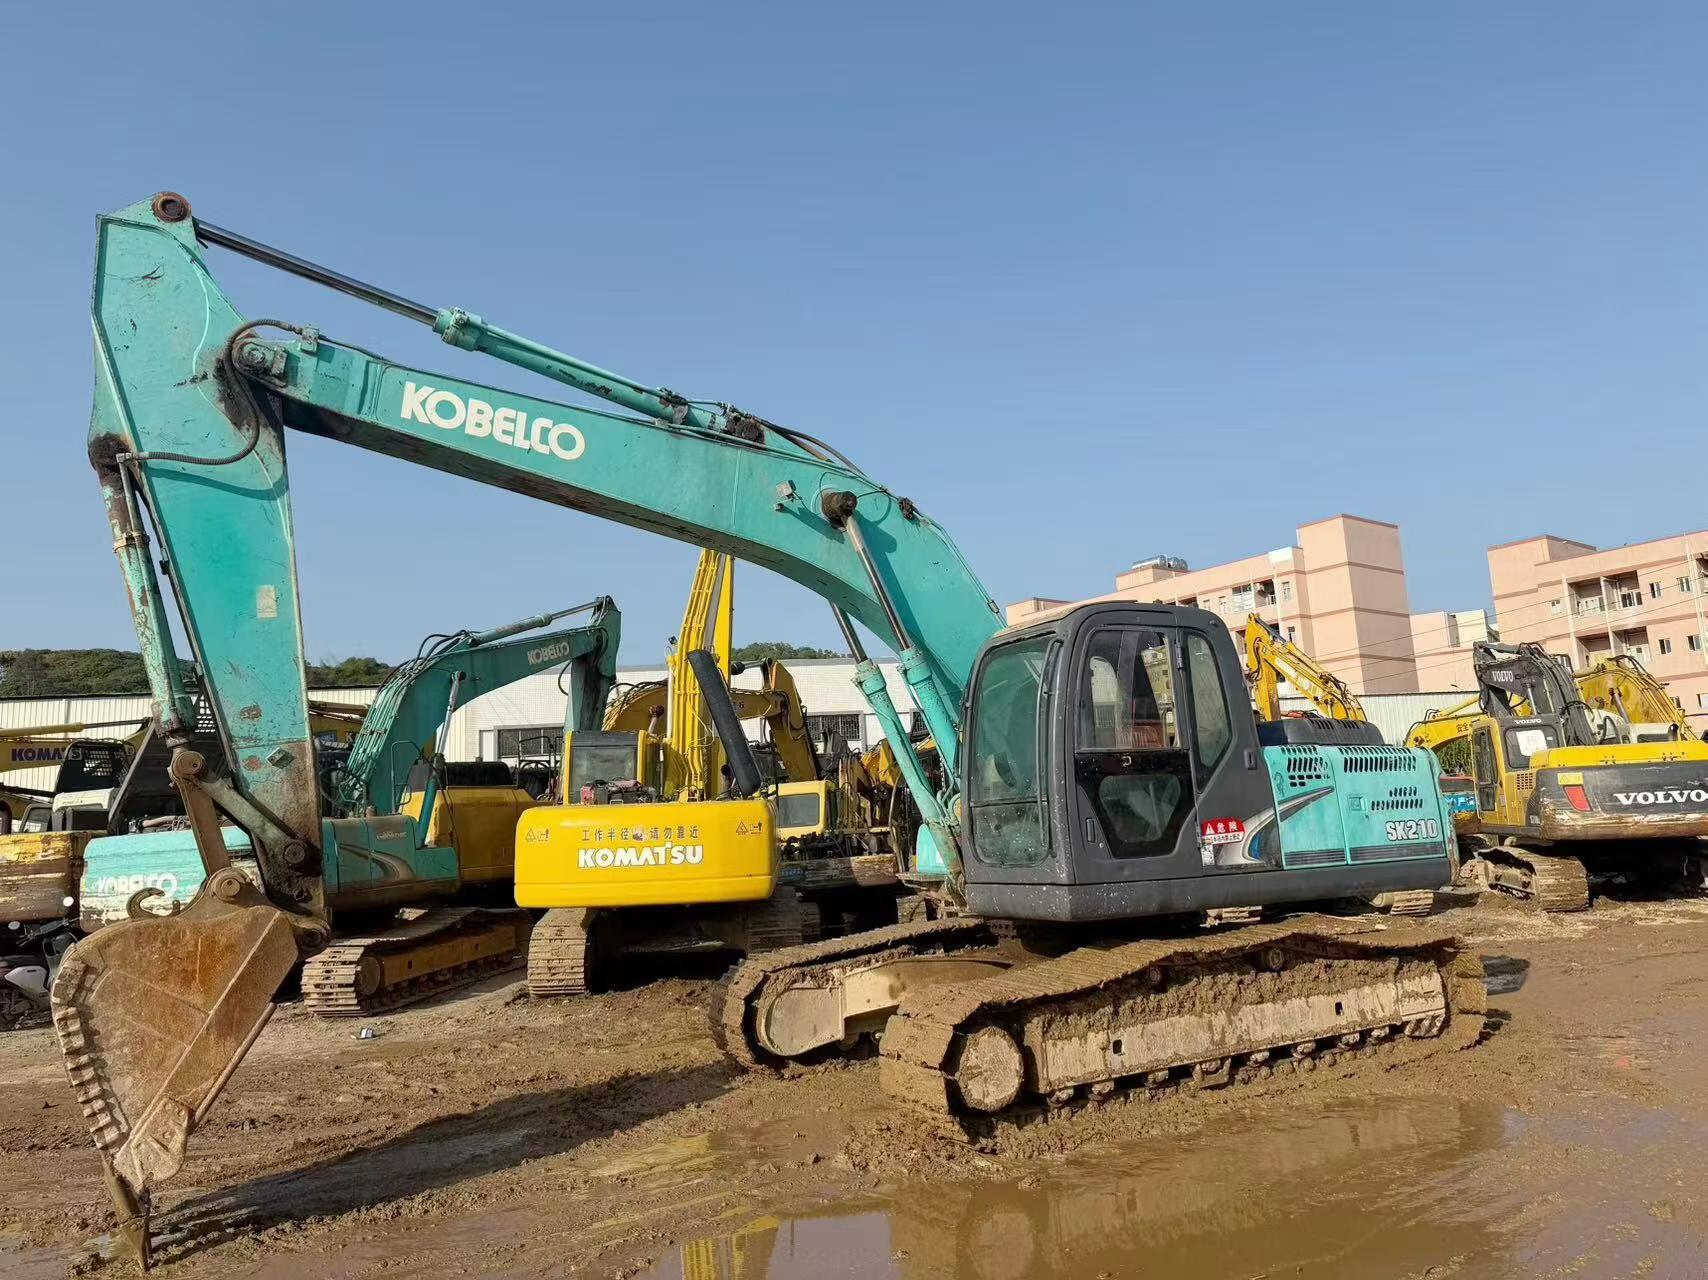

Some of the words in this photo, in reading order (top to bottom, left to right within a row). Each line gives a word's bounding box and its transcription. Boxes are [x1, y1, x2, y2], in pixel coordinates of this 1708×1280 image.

[400, 380, 586, 461] KOBELCO
[527, 641, 570, 666] KOBELCO
[1491, 670, 1514, 683] VOLVO
[1613, 789, 1706, 806] VOLVO
[1385, 818, 1439, 841] SK210
[577, 841, 704, 869] KOMATSU
